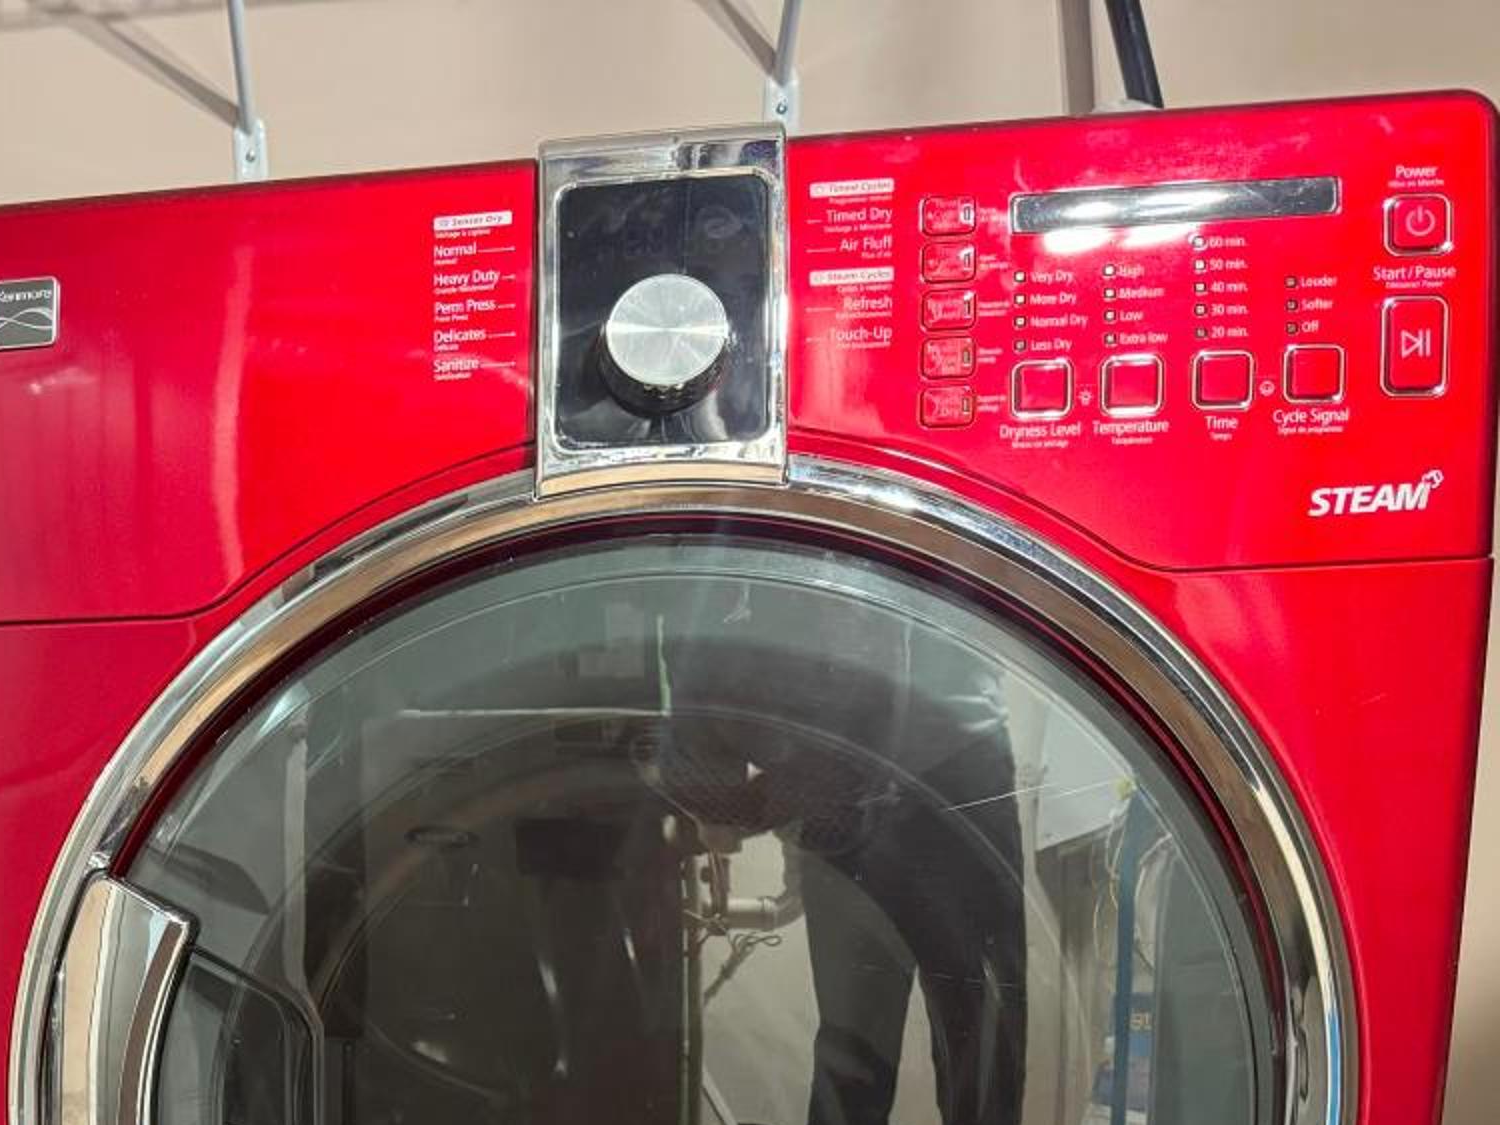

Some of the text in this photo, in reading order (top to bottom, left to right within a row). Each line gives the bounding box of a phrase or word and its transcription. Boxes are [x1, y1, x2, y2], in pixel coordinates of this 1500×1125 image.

[1395, 165, 1438, 179] Power
[826, 206, 893, 223] Timed Dry
[433, 241, 477, 257] Normal
[841, 238, 858, 252] Air
[433, 269, 500, 288] Heavy Duty
[1204, 415, 1239, 430] Time
[1272, 407, 1349, 428] Cycle Signal
[999, 421, 1082, 440] Dryness Level
[1092, 420, 1170, 436] Temperature
[1307, 483, 1433, 518] STEAM
